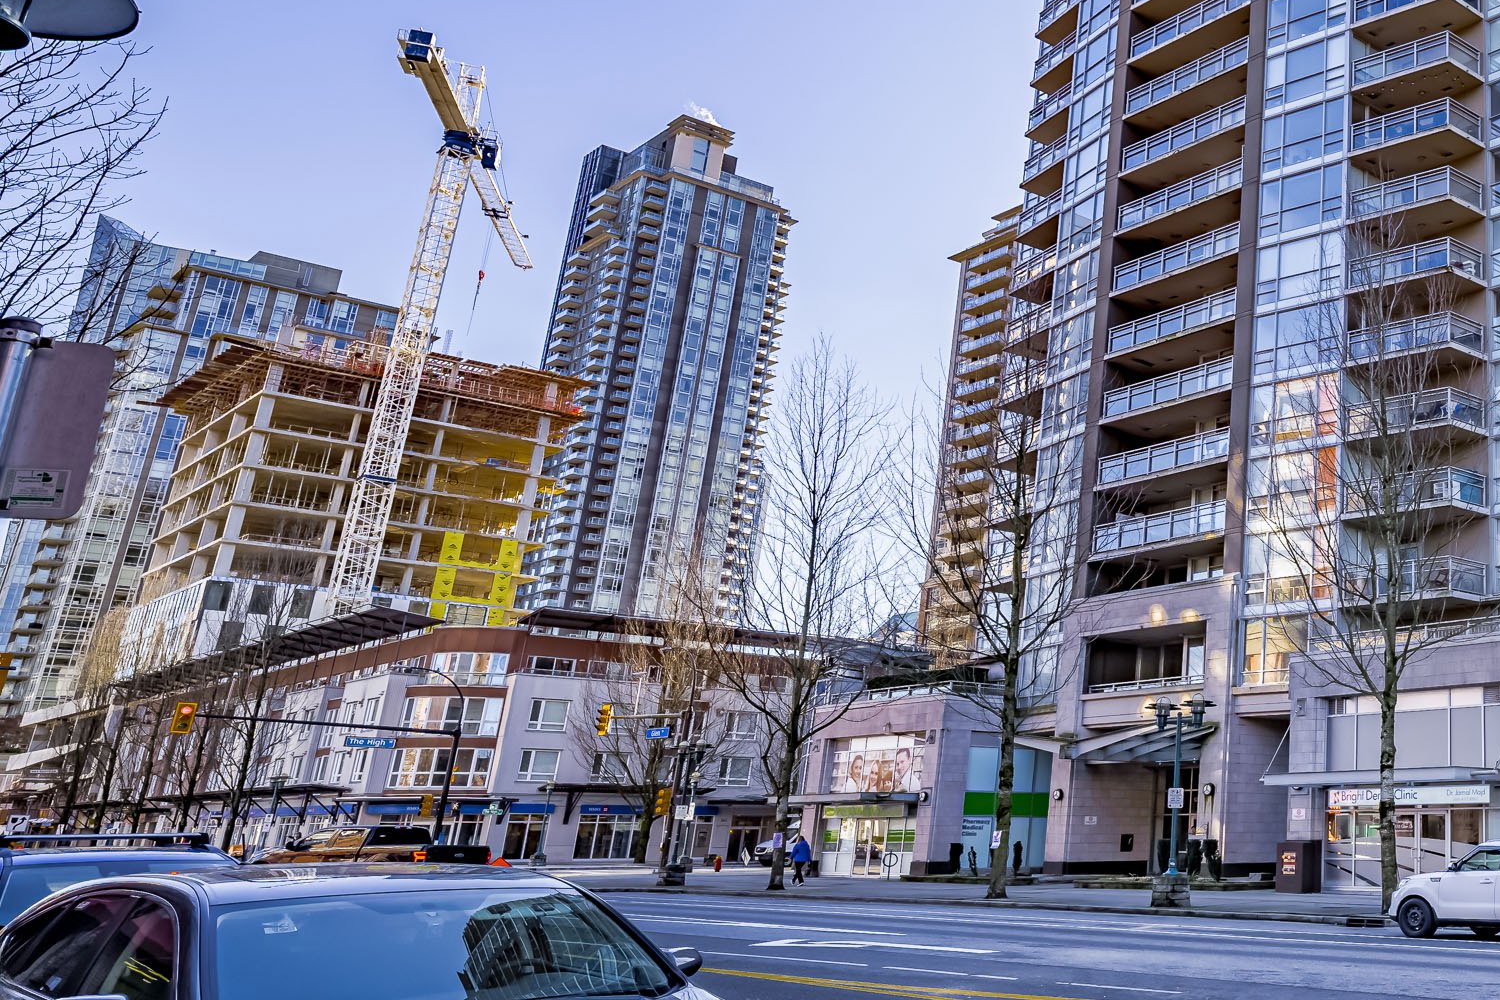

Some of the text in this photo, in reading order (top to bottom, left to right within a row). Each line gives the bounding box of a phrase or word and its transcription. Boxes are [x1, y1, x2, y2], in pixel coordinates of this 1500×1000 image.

[367, 739, 386, 747] High
[1341, 790, 1364, 804] Bright
[1394, 788, 1418, 800] Clinic
